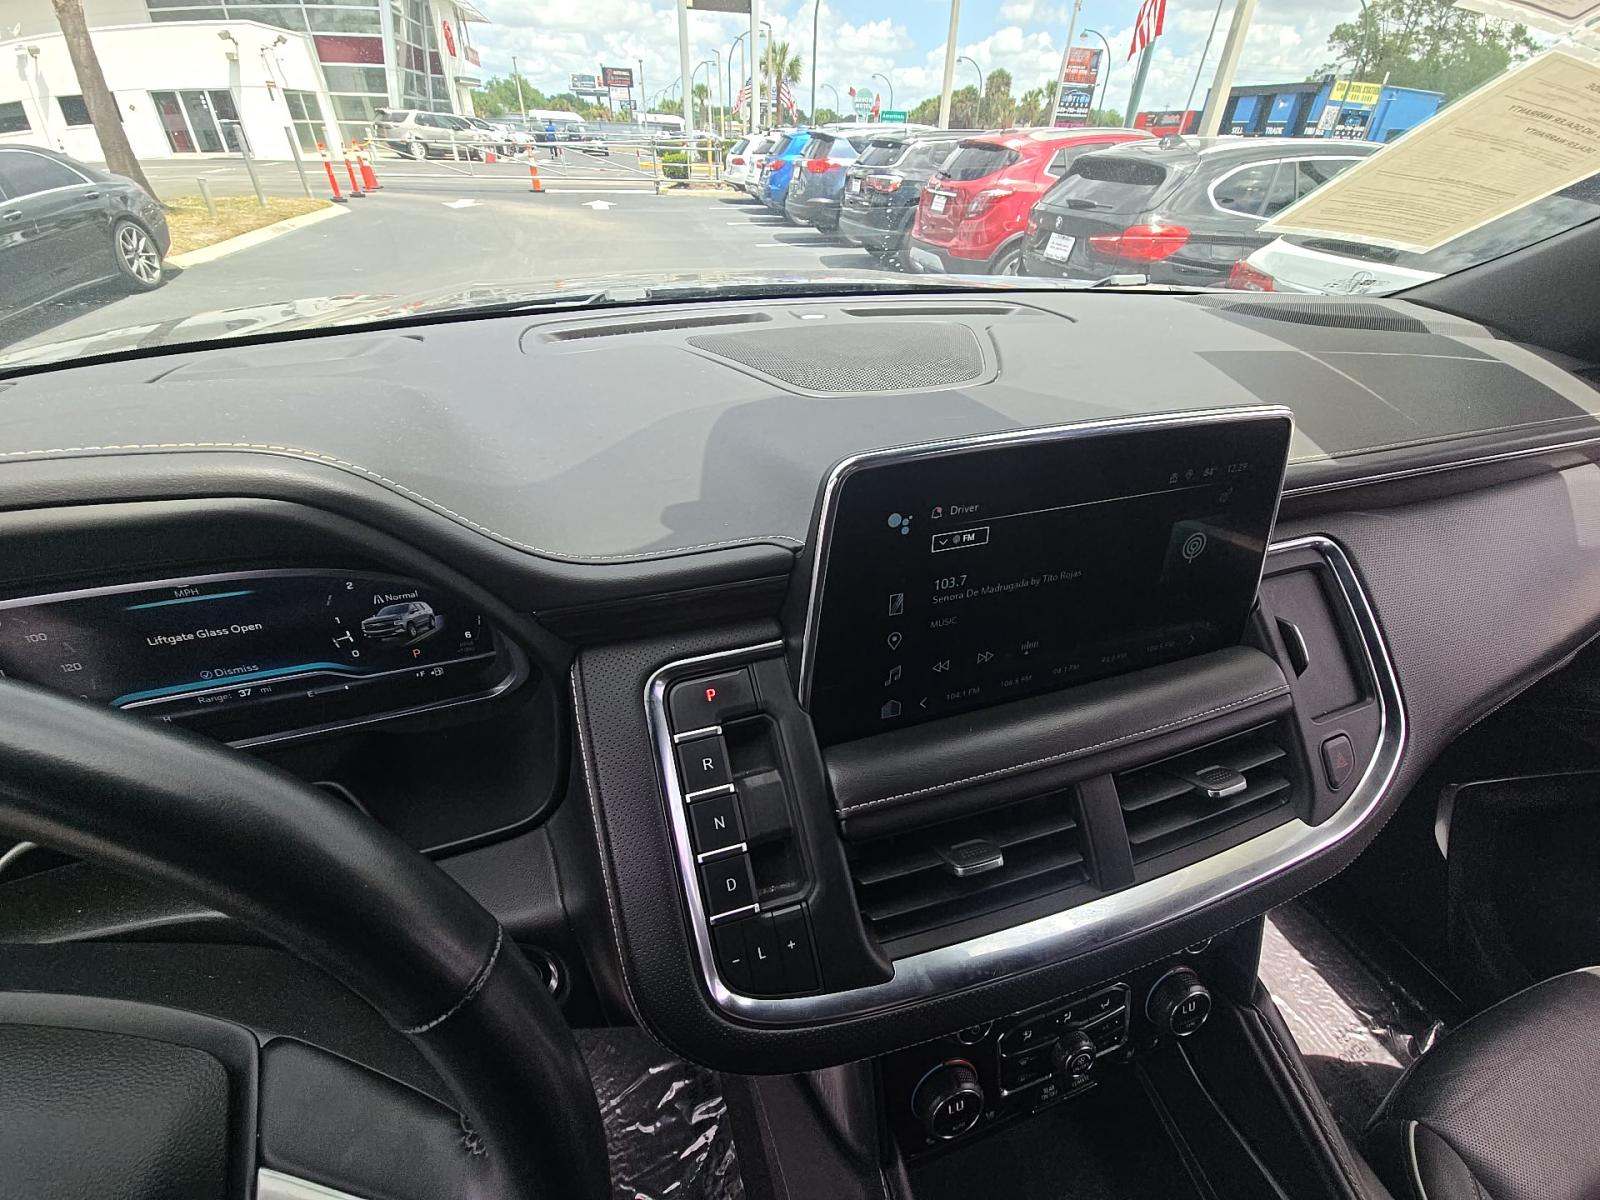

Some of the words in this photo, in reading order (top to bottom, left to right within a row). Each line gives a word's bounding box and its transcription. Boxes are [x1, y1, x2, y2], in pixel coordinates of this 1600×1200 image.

[950, 504, 979, 516] Driver
[962, 533, 976, 543] FM
[346, 581, 355, 590] 2
[934, 574, 967, 591] 103.7
[966, 588, 978, 598] De
[981, 579, 1029, 595] Madrugada
[1030, 577, 1041, 588] by
[1042, 573, 1058, 584] Tito
[1060, 568, 1082, 581] Rojas
[174, 588, 199, 598] MPH
[385, 590, 418, 602] Normal
[930, 616, 957, 629] MUSIC
[25, 633, 47, 643] 100
[147, 631, 195, 646] Liftgate
[196, 627, 229, 639] Glass
[230, 623, 263, 635] Open
[413, 649, 421, 659] P
[60, 662, 82, 673] 120
[214, 664, 259, 678] Dismiss
[197, 693, 233, 704] Range:
[238, 688, 252, 697] 37
[260, 686, 272, 694] mi
[706, 688, 716, 702] P
[702, 758, 714, 771] R
[714, 815, 726, 830] N
[726, 878, 736, 891] D
[757, 946, 767, 960] L
